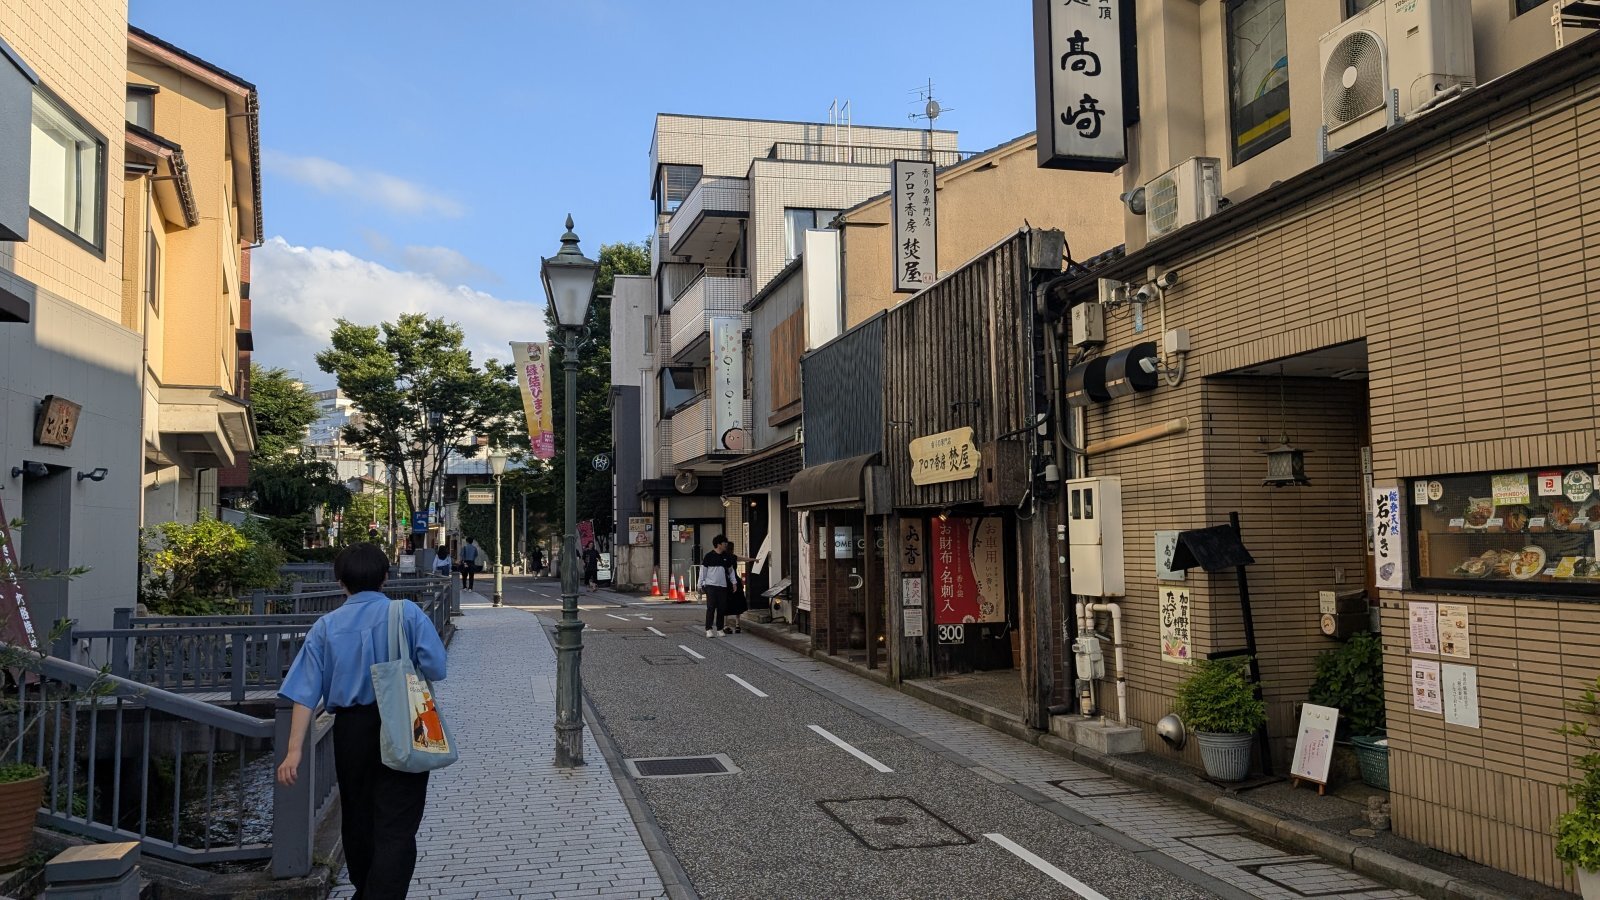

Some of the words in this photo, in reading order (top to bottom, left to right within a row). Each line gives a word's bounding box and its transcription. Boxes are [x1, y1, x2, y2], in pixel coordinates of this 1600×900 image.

[1376, 494, 1391, 558] 岩がき
[1389, 490, 1399, 536] 能登天然
[904, 525, 921, 565] お香
[940, 523, 955, 613] お財布・名刺入
[939, 625, 963, 641] 300
[1179, 591, 1189, 641] 加賀野菜
